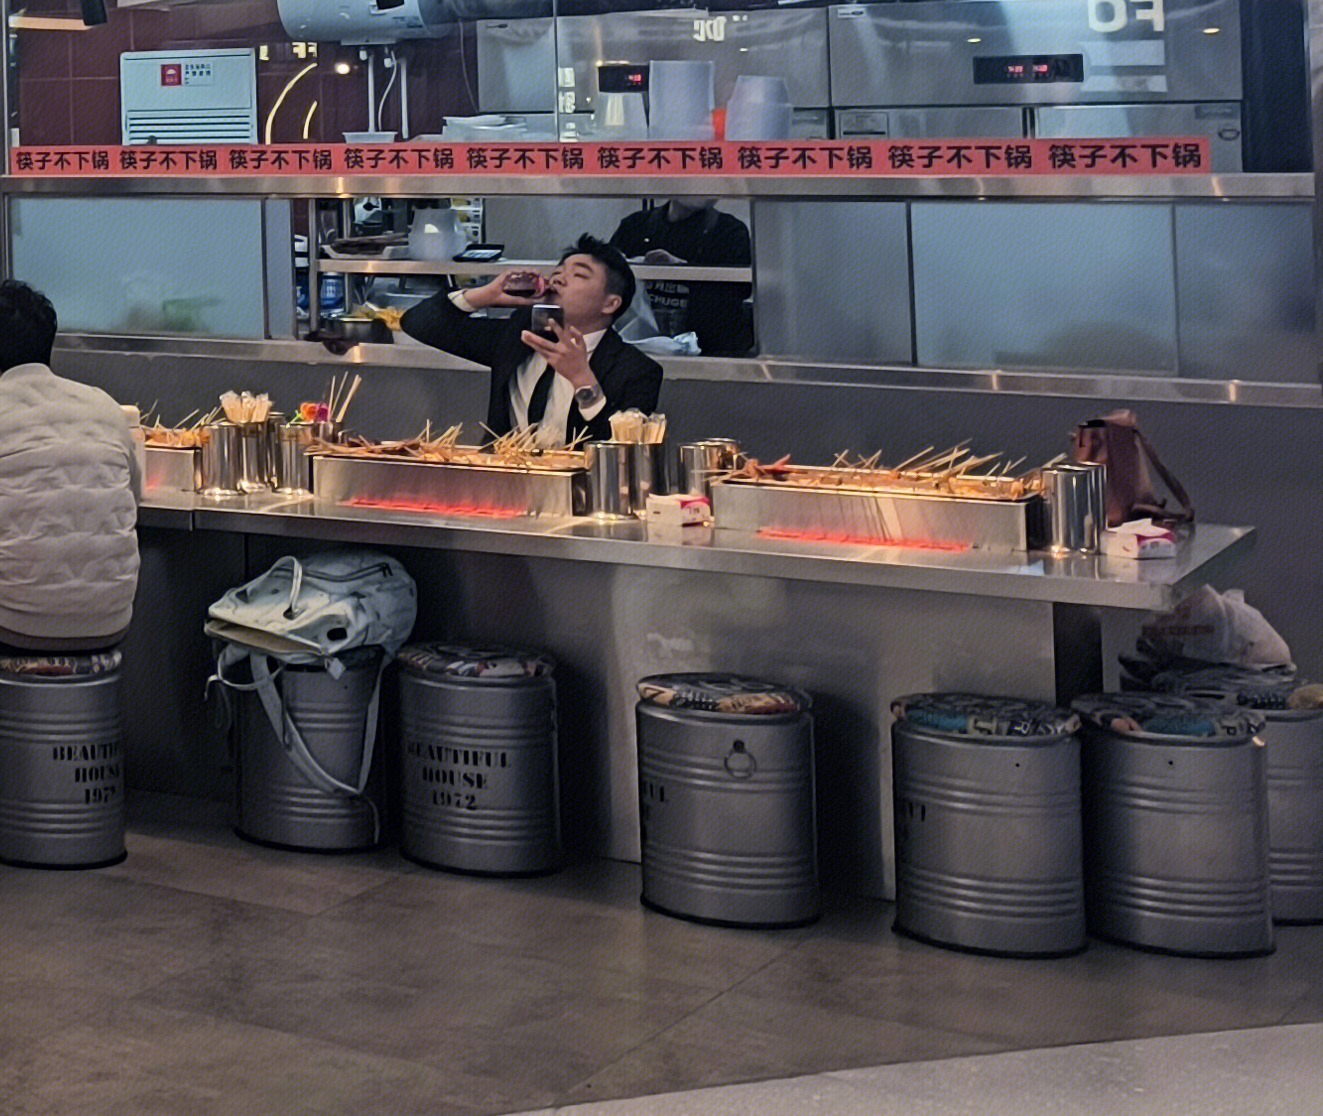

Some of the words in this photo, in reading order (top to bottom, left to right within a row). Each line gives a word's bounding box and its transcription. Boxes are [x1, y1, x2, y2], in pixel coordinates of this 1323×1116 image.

[16, 149, 109, 171] 筷子不下锅
[119, 149, 218, 171] 筷子不下锅
[229, 148, 333, 171] 筷子不下锅
[344, 148, 454, 171] 筷子不下锅
[466, 147, 584, 171] 筷子不下锅
[597, 146, 723, 171] 筷子不下锅
[738, 146, 873, 171] 筷子不下锅
[888, 145, 1033, 171] 筷子不下锅
[1048, 144, 1202, 170] 筷子不下锅
